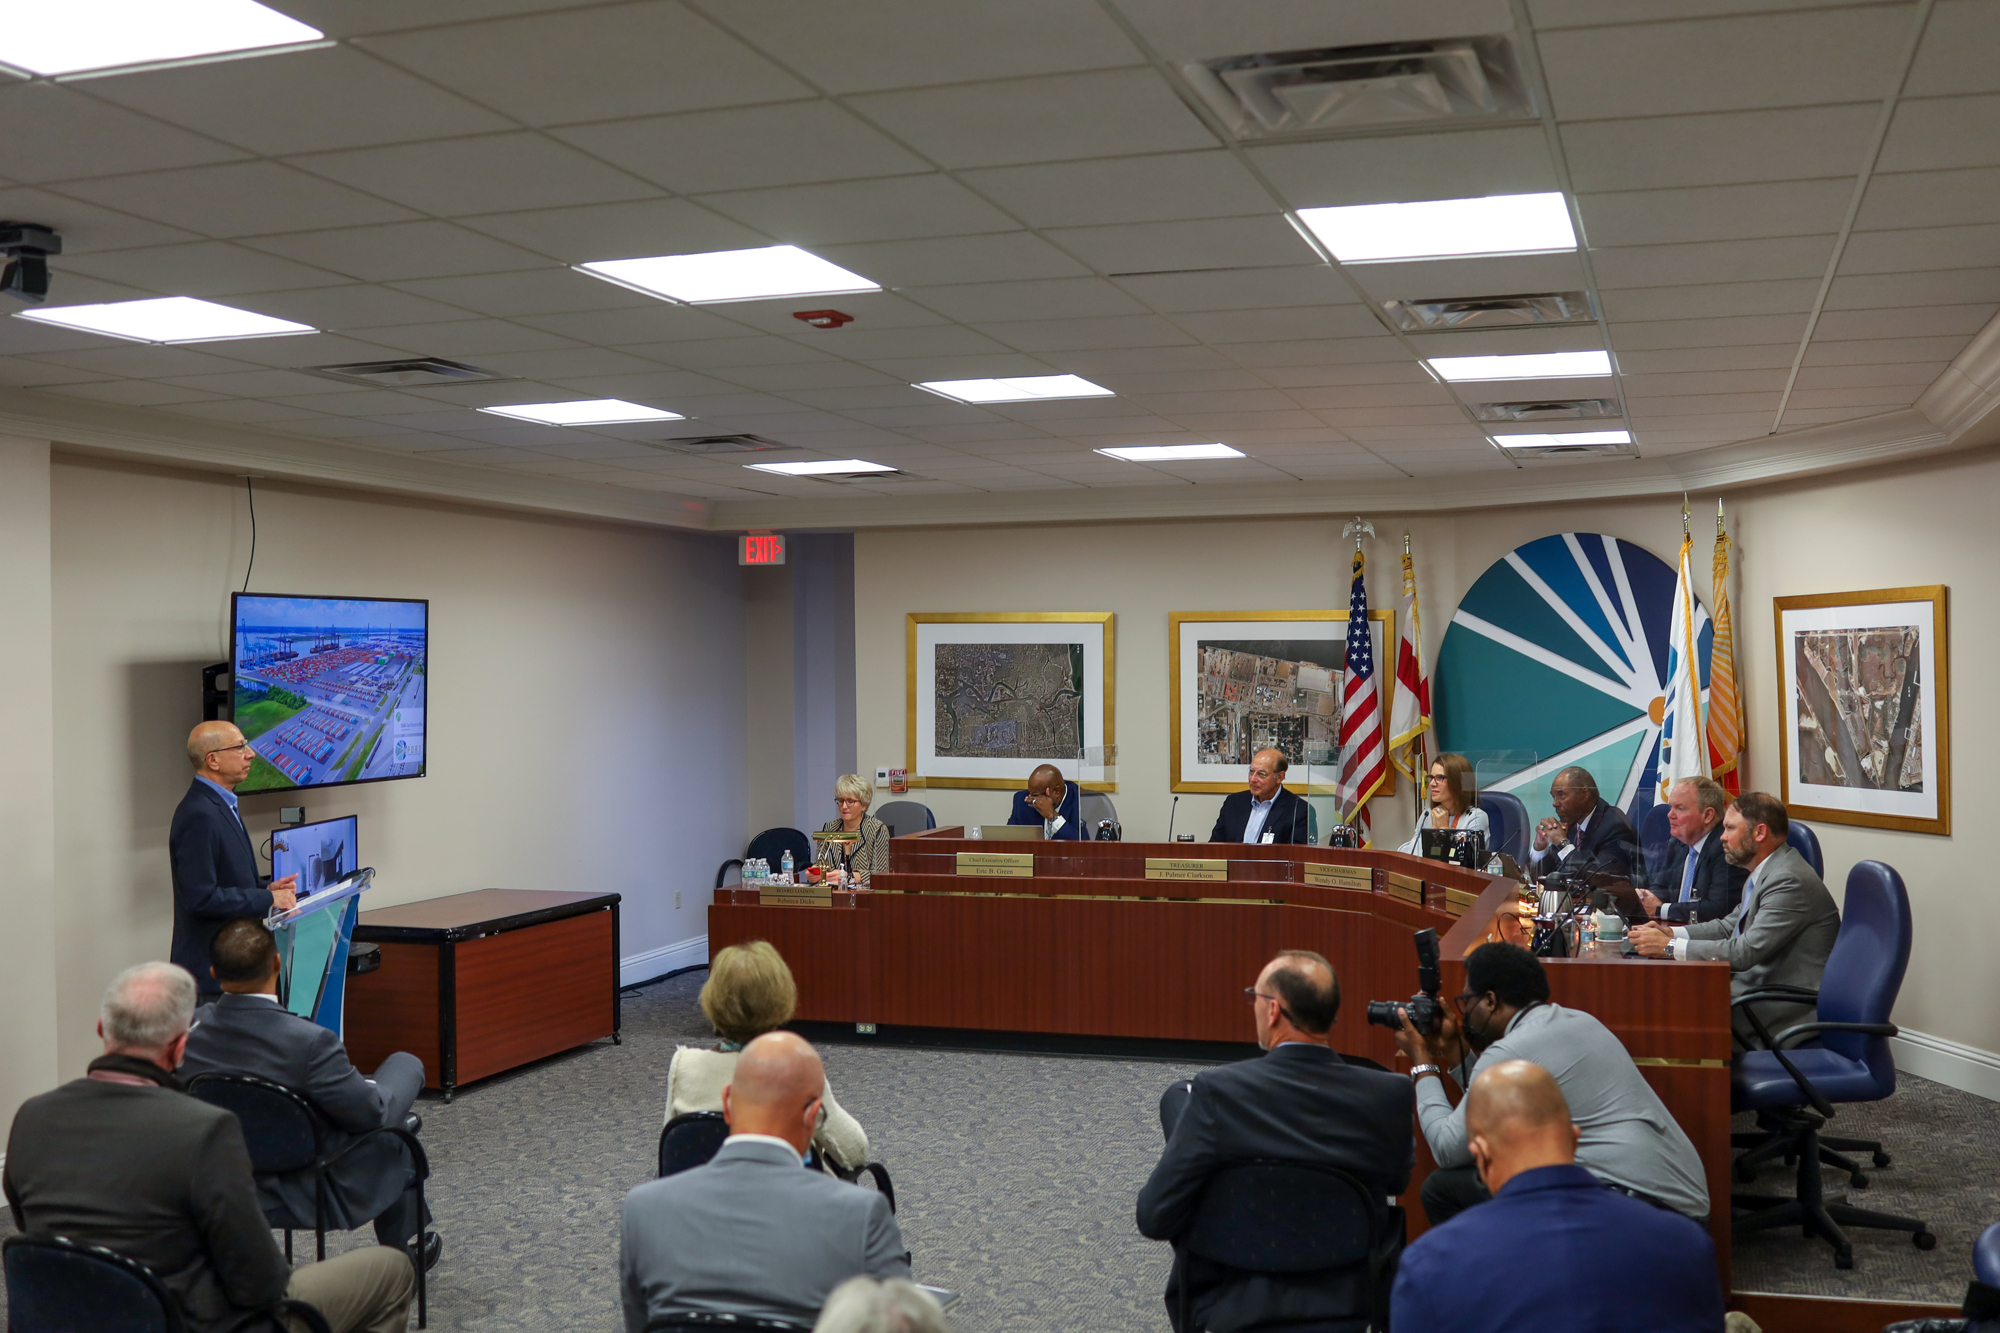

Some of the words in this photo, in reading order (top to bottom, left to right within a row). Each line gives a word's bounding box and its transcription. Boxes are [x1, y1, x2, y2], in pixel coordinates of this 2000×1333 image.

[746, 536, 778, 563] EXIT
[1314, 877, 1330, 885] Wendy
[1339, 879, 1362, 887] Hamilton
